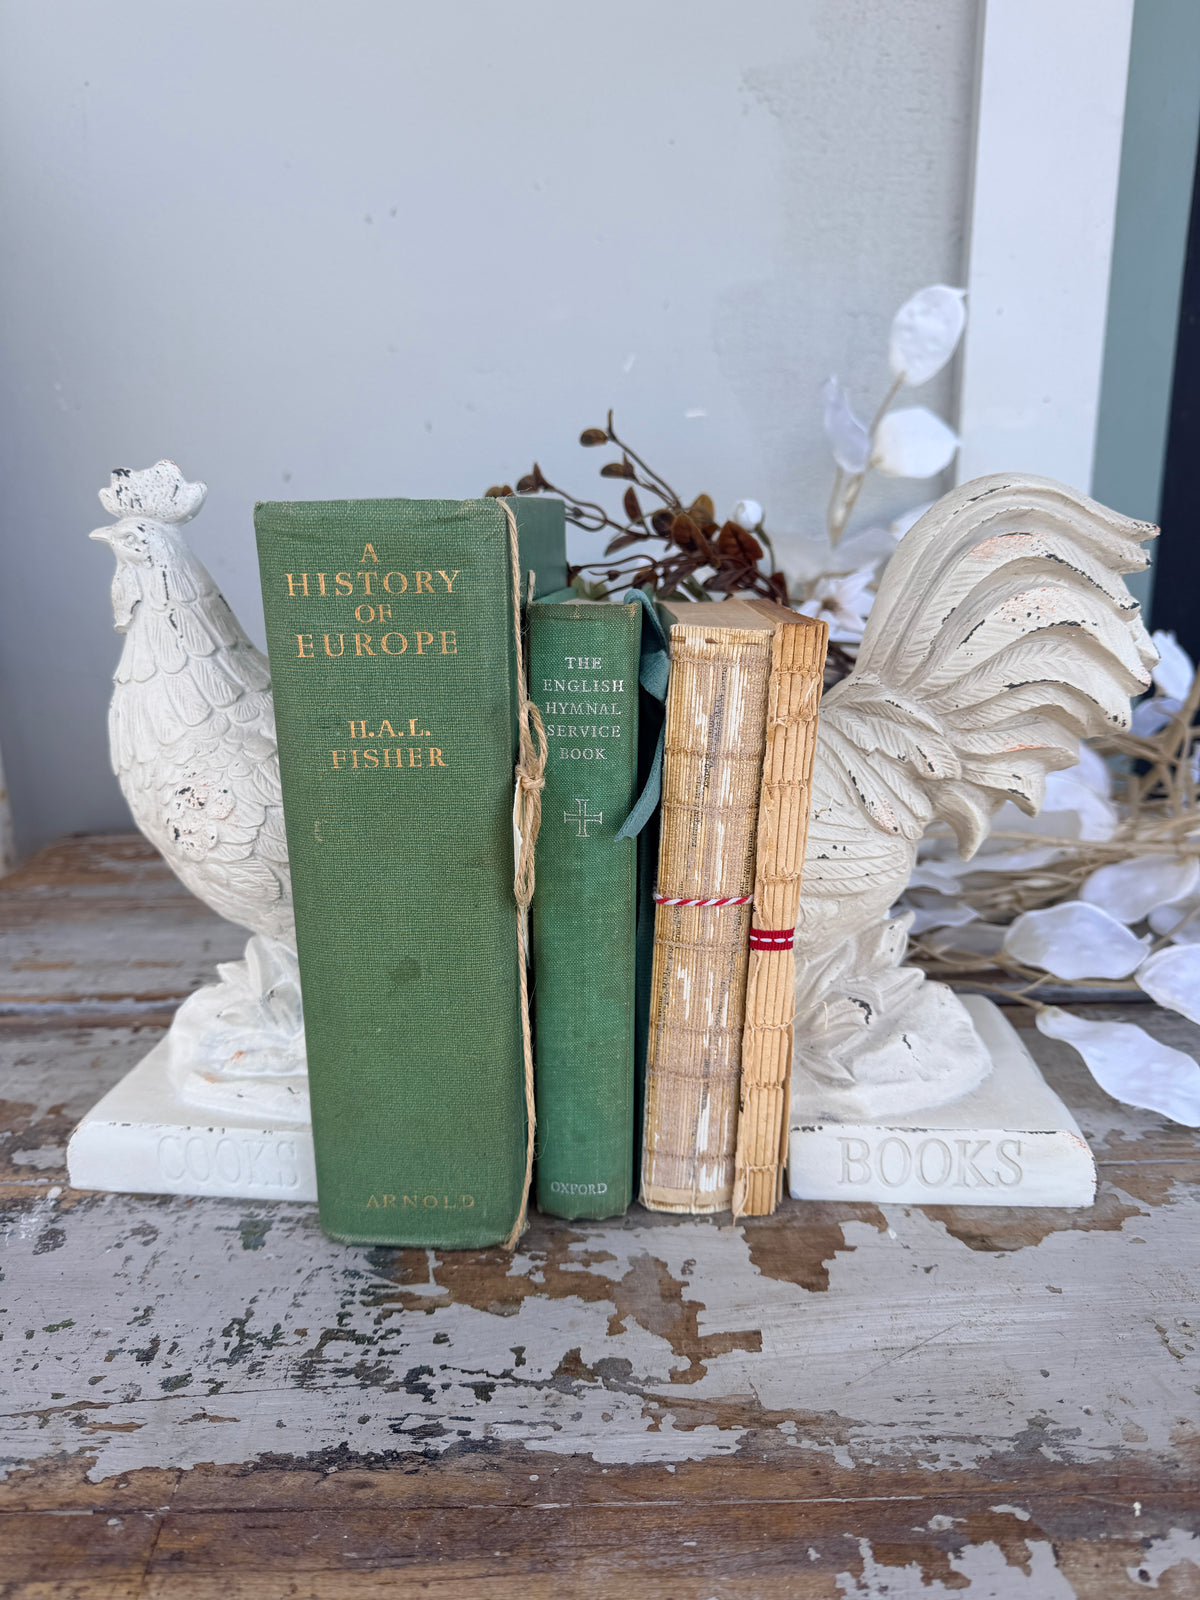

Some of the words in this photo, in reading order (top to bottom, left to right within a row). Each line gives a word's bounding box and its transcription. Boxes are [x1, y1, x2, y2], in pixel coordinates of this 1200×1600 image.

[359, 543, 381, 563] A
[285, 570, 461, 597] HISTORY
[354, 604, 392, 623] OF
[294, 630, 458, 658] EUROPE
[564, 657, 602, 670] THE
[542, 679, 625, 693] ENGLISH
[545, 702, 622, 715] HYMNAL
[348, 718, 431, 739] H.A.L.
[547, 725, 621, 738] SERVICE
[331, 747, 449, 769] FISHER
[559, 748, 607, 760] BOOK
[157, 1134, 300, 1190] COOKS
[836, 1136, 1024, 1188] BOOKS
[550, 1181, 608, 1195] OXFORD
[366, 1194, 475, 1209] ARNOLD
